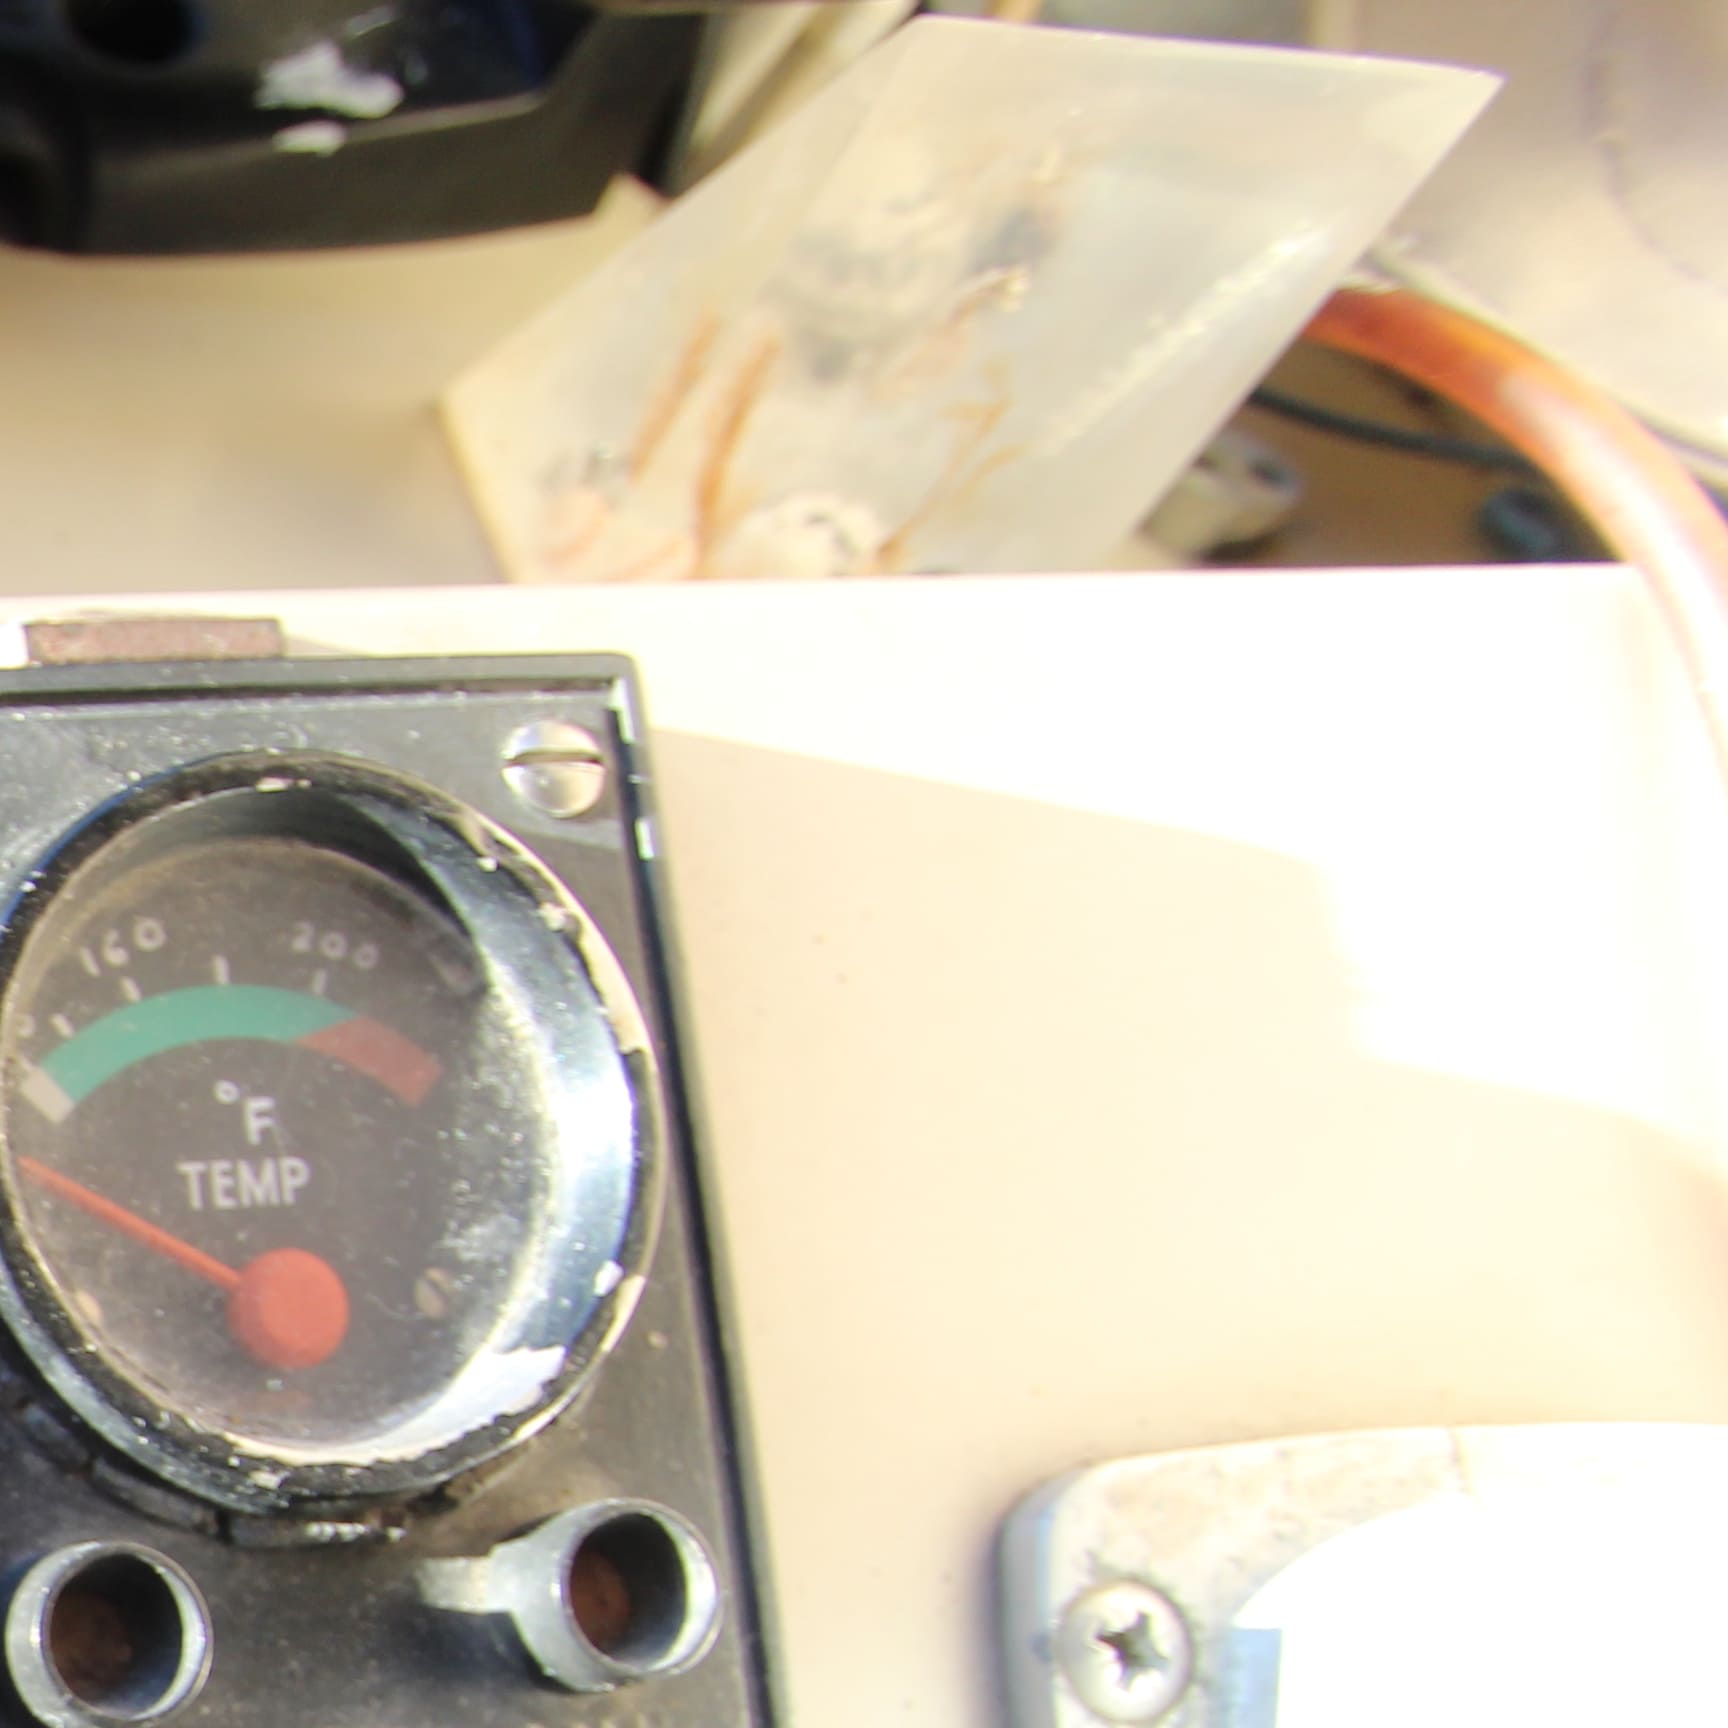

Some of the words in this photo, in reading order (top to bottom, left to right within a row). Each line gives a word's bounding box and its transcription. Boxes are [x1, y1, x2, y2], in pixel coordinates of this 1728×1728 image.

[79, 917, 168, 977] 160
[291, 921, 380, 970] 200
[177, 1156, 311, 1211] TEMP
